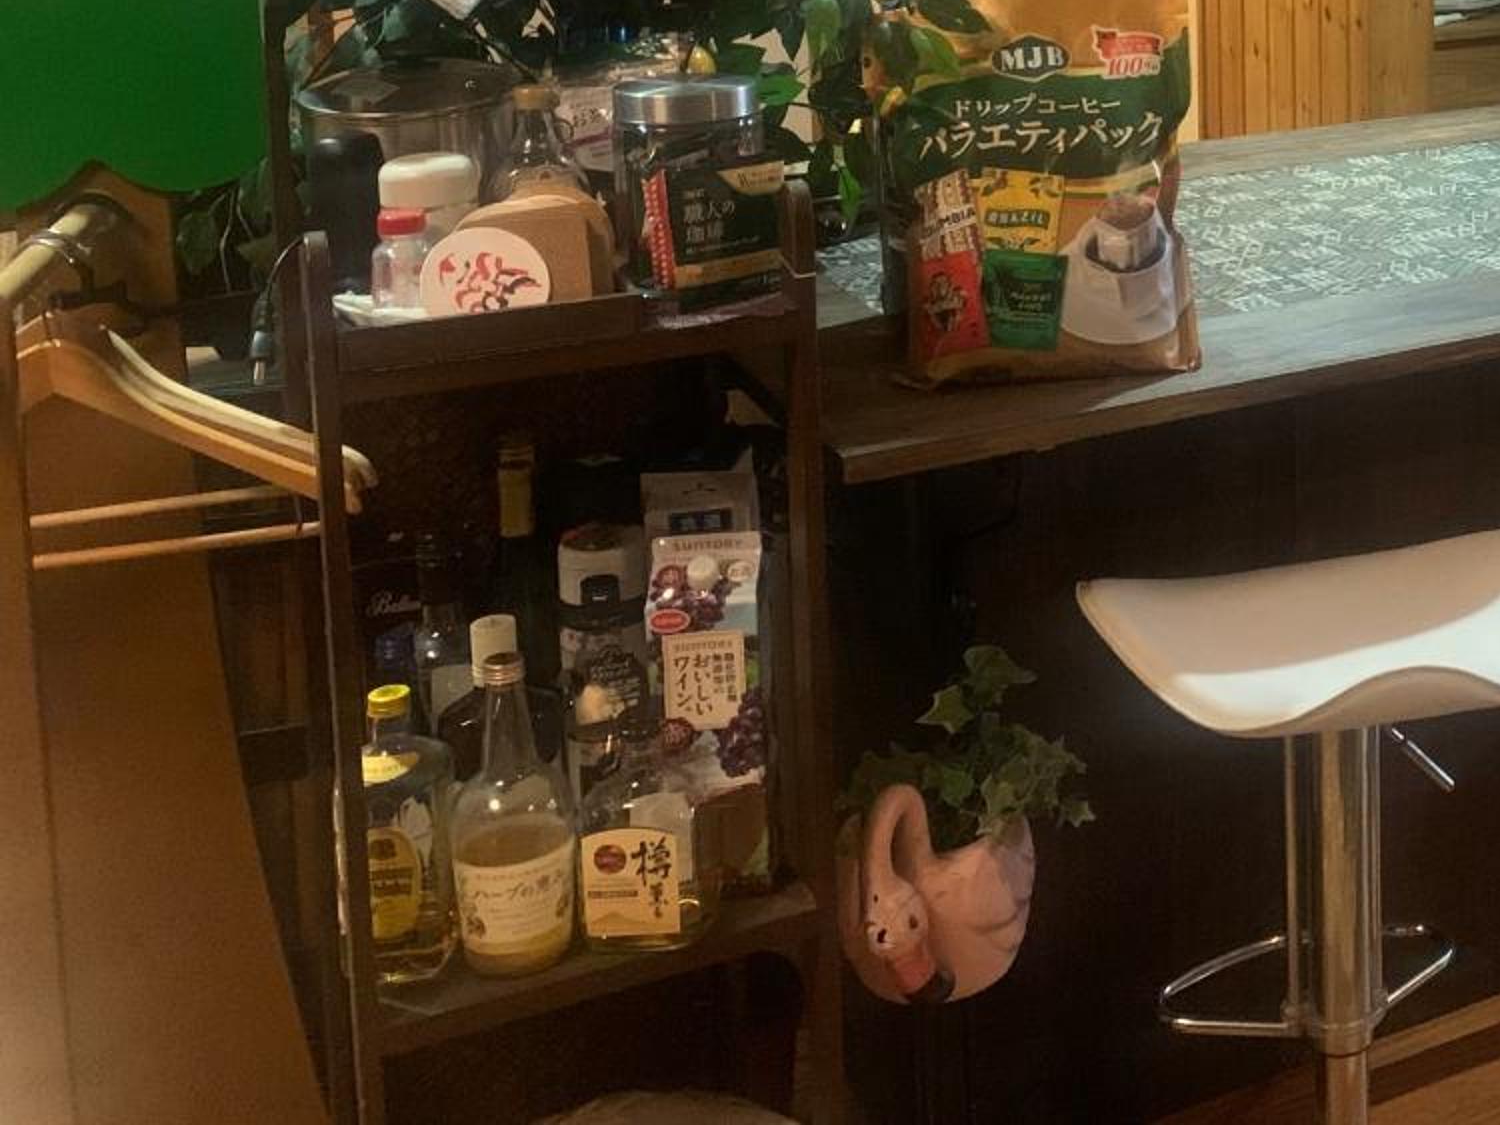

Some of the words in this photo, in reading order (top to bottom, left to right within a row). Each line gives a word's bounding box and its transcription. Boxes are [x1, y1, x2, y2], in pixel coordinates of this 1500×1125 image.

[1000, 46, 1065, 72] MJB
[955, 92, 1121, 118] ドリップコーヒー
[920, 112, 1163, 159] バラエティパック
[673, 539, 743, 552] SUNTORY
[692, 653, 713, 716] おいしい
